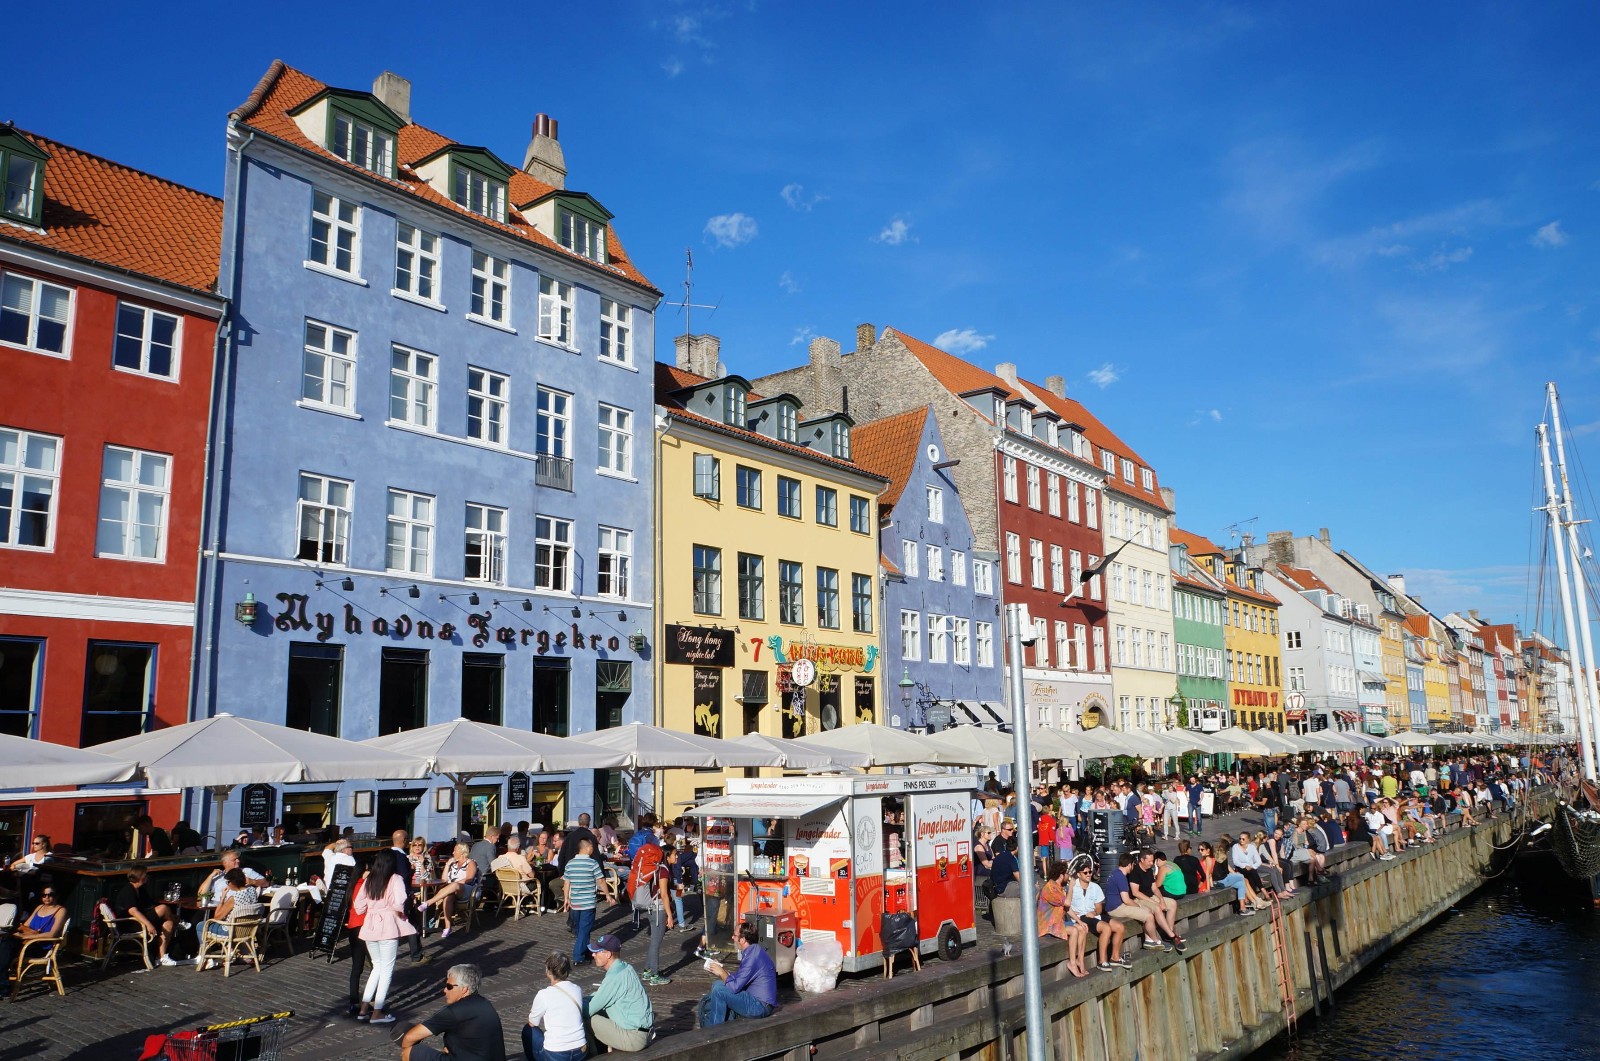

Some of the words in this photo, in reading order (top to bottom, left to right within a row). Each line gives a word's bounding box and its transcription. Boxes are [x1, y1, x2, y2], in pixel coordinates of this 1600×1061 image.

[275, 592, 456, 642] Nyhavns
[467, 610, 620, 656] Færgekro
[677, 627, 703, 649] Hong
[750, 637, 764, 663] 7
[1288, 695, 1301, 708] 17
[903, 781, 918, 790] FINNS
[918, 780, 937, 789] PØLSER
[795, 827, 841, 841] Langelænder
[917, 813, 966, 840] Langelænder
